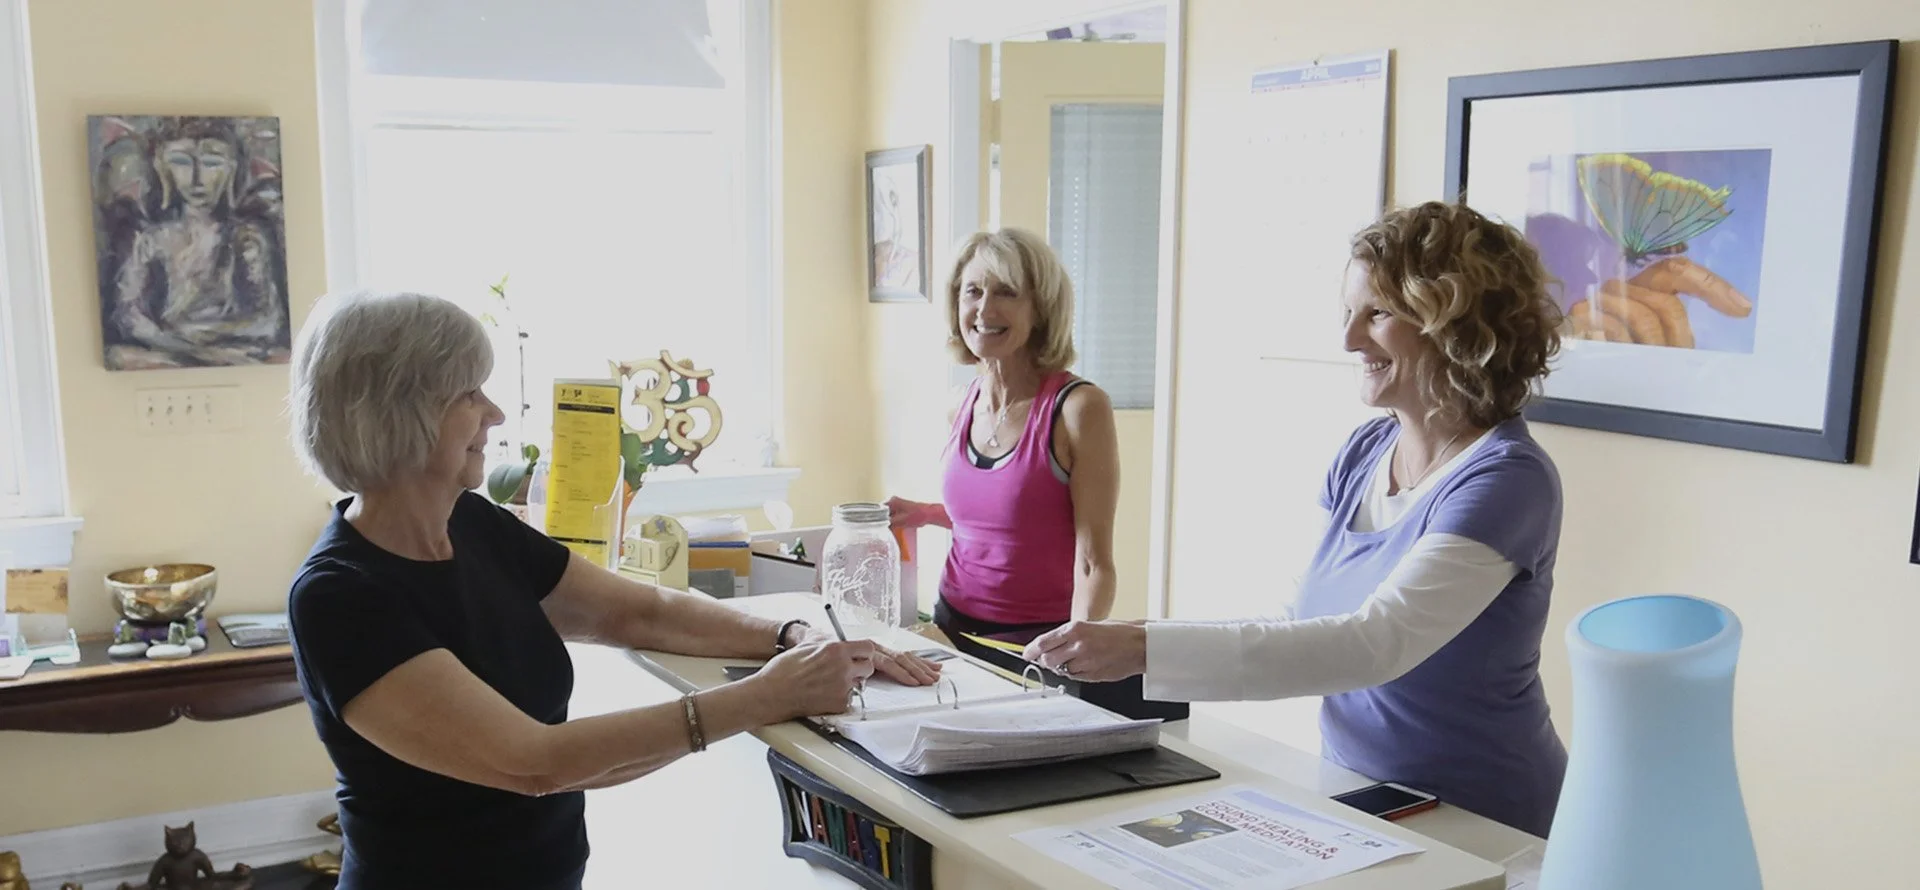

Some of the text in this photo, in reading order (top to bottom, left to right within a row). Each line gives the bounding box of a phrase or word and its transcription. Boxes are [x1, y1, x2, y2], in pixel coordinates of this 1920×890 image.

[1300, 67, 1328, 81] APRIL
[826, 564, 870, 590] Ball
[1194, 805, 1239, 825] GONG
[1237, 823, 1335, 861] MEDITATION
[1206, 801, 1259, 823] SOUND
[1258, 821, 1326, 848] HEALING
[1325, 846, 1339, 854] &
